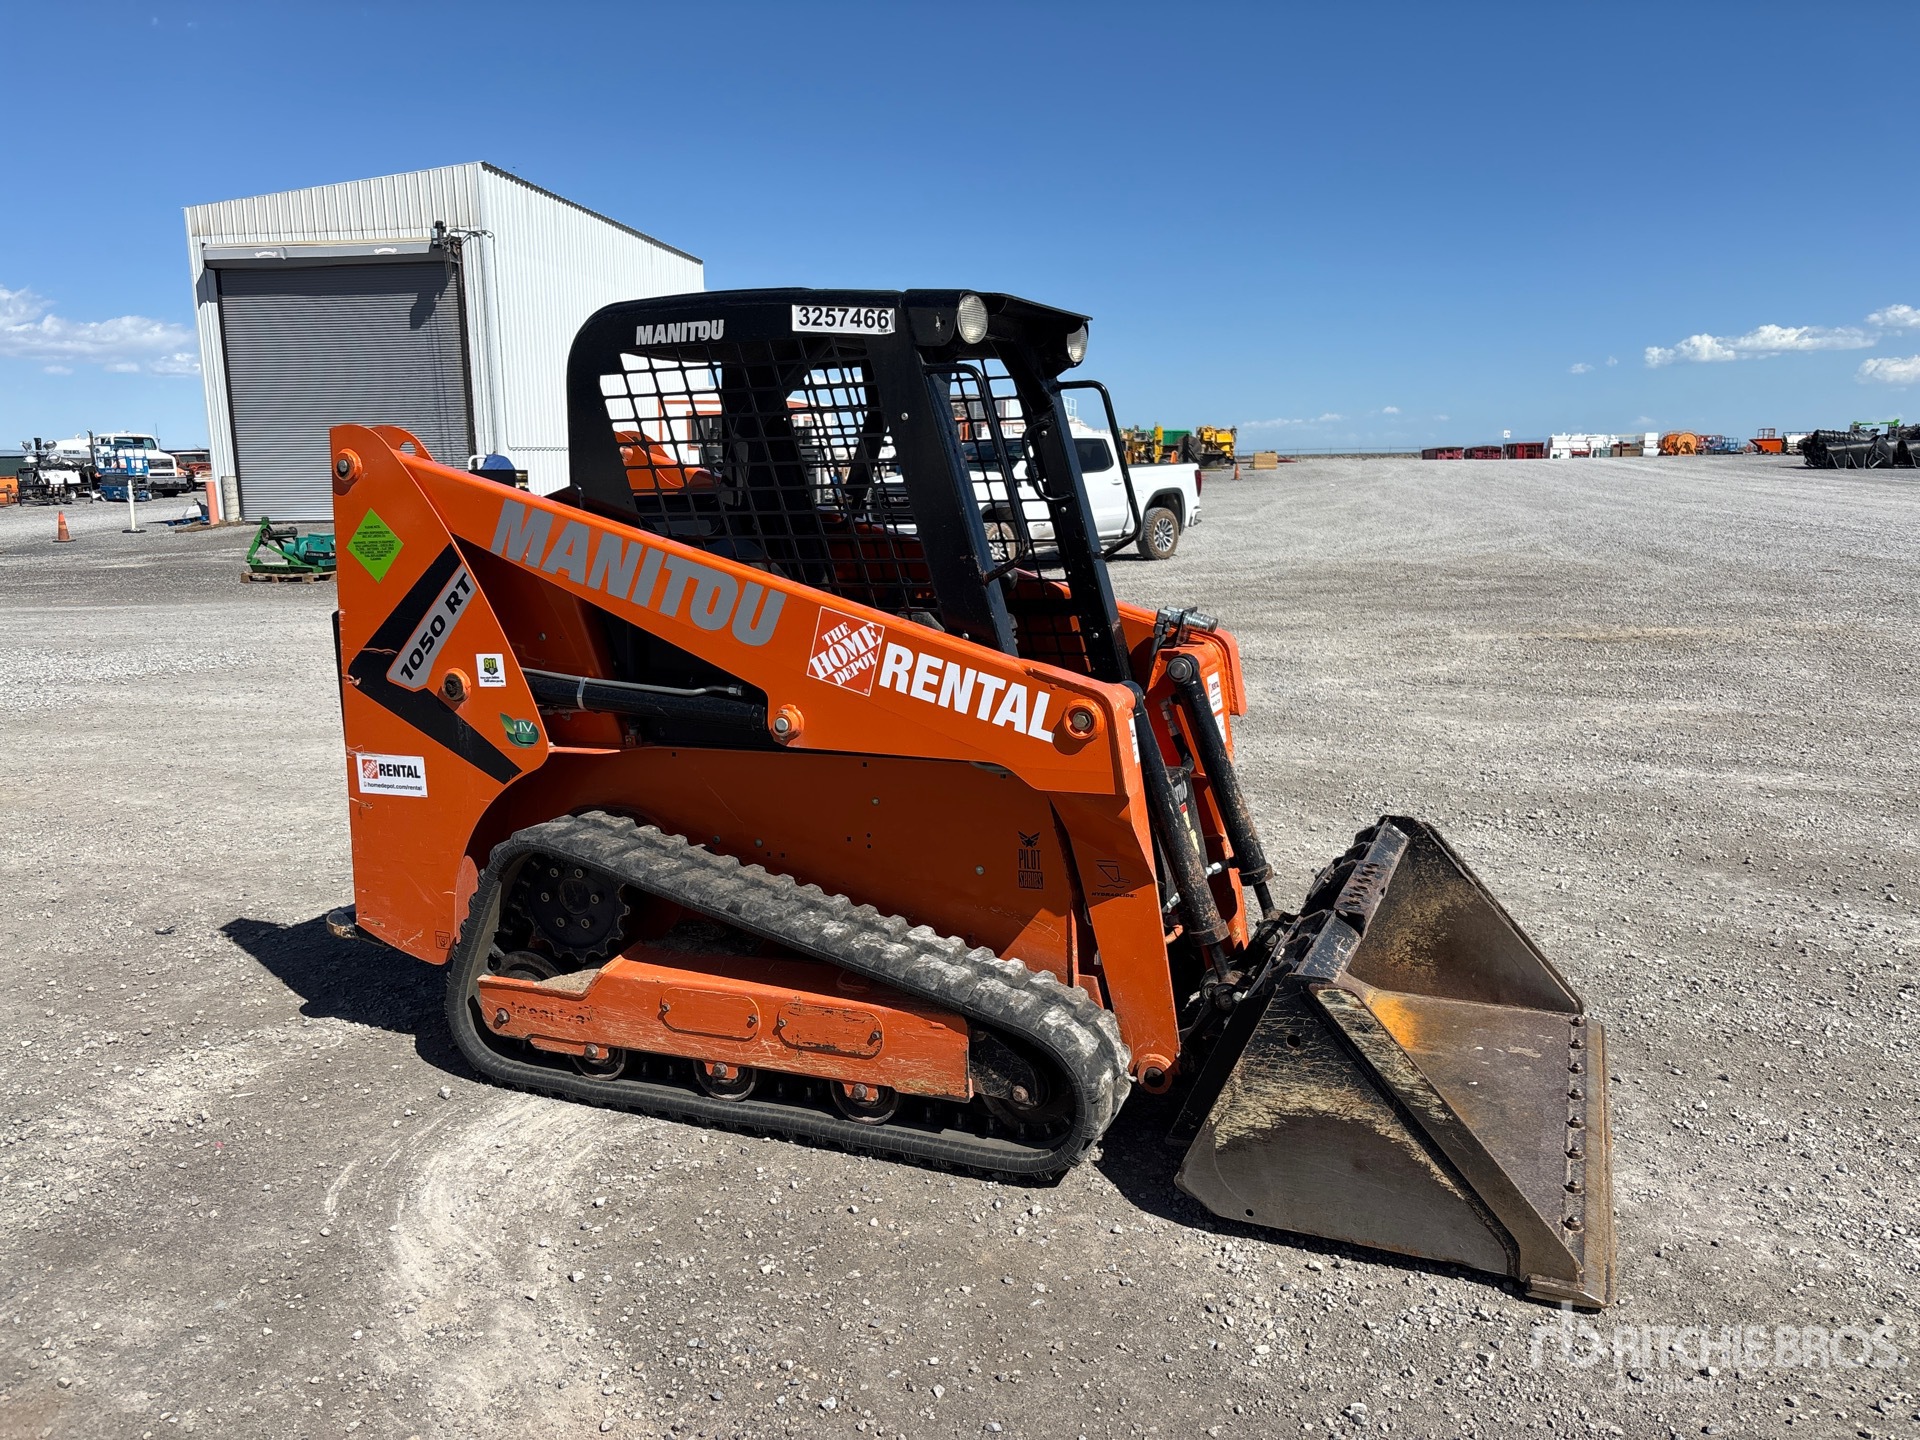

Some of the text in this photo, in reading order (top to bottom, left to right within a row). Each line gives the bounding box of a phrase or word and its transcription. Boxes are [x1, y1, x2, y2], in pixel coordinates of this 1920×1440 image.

[798, 306, 889, 329] 3257466
[635, 319, 724, 346] MANITOU
[490, 498, 787, 647] MANITOU
[400, 573, 472, 681] 1050 RT
[821, 621, 852, 647] THE
[484, 658, 496, 669] 811
[810, 622, 883, 681] HOME
[833, 650, 878, 686] DEPOT
[878, 642, 1055, 744] RENTAL
[379, 763, 421, 779] RENTAL
[368, 782, 423, 791] homedepot.com/rental
[1018, 849, 1041, 870] PILOT
